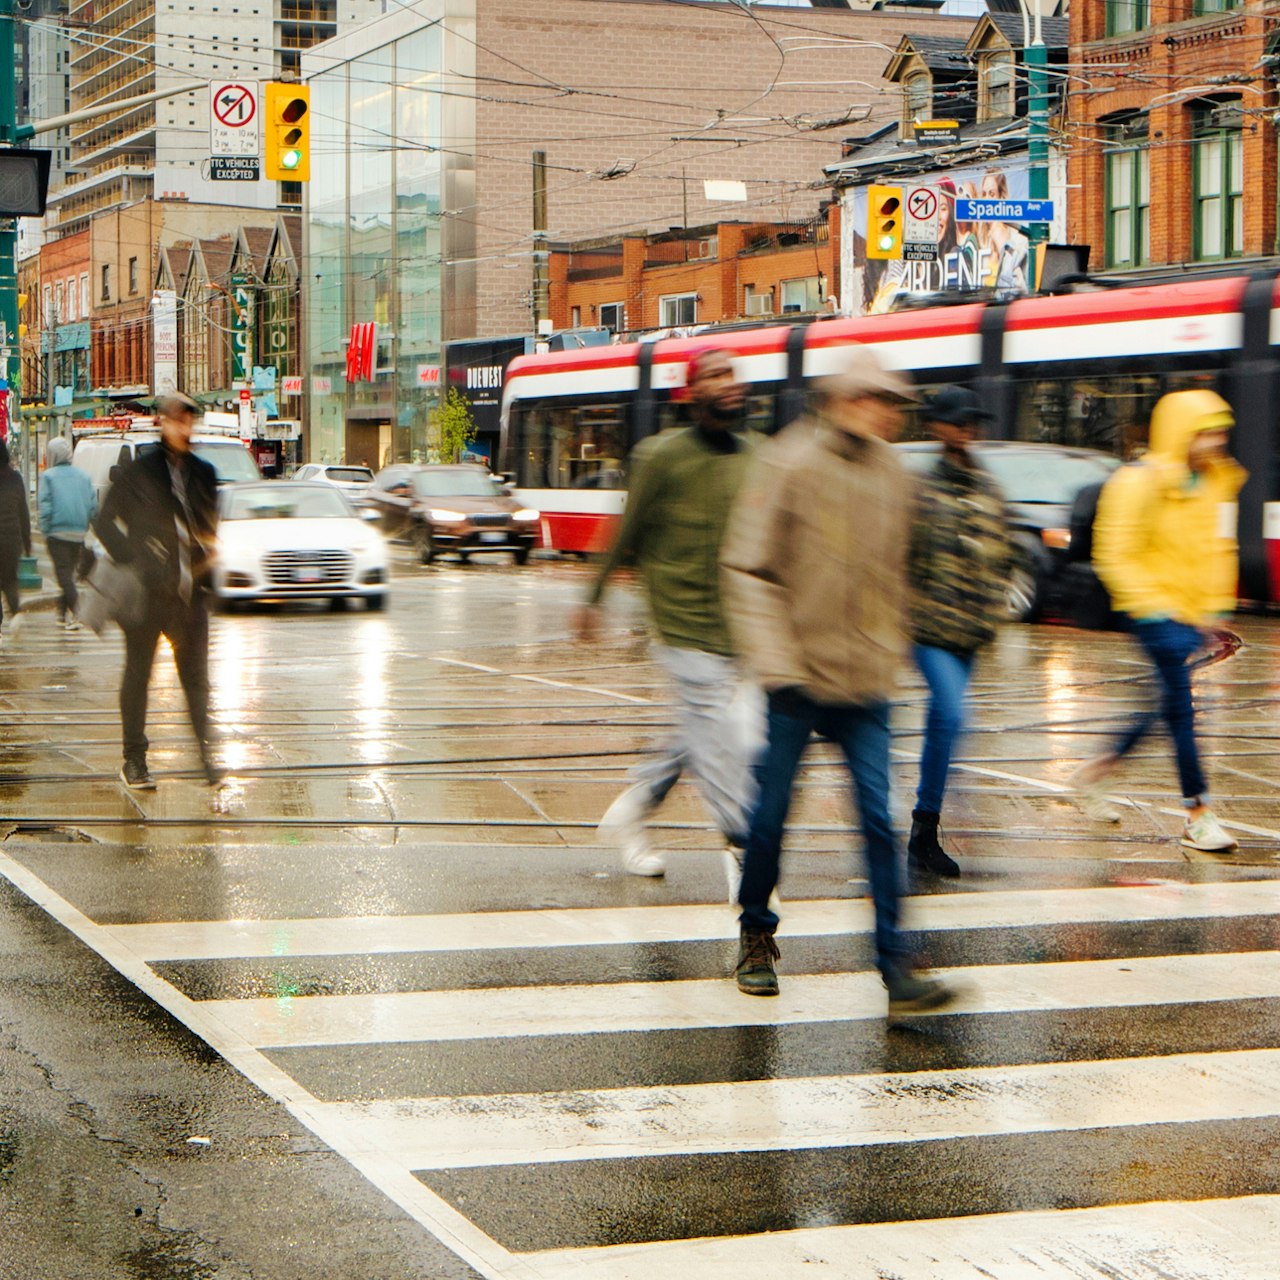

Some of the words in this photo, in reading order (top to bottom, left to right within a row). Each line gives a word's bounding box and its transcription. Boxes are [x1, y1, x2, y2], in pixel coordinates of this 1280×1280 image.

[211, 159, 224, 167] TTC
[226, 159, 259, 168] VEHICLES
[217, 170, 253, 179] EXCEPTED
[968, 201, 1023, 219] Spadina
[1027, 202, 1041, 211] Ave
[907, 252, 933, 260] EXCEPTED
[897, 248, 992, 293] ARDENE
[467, 366, 503, 389] DUEWEST
